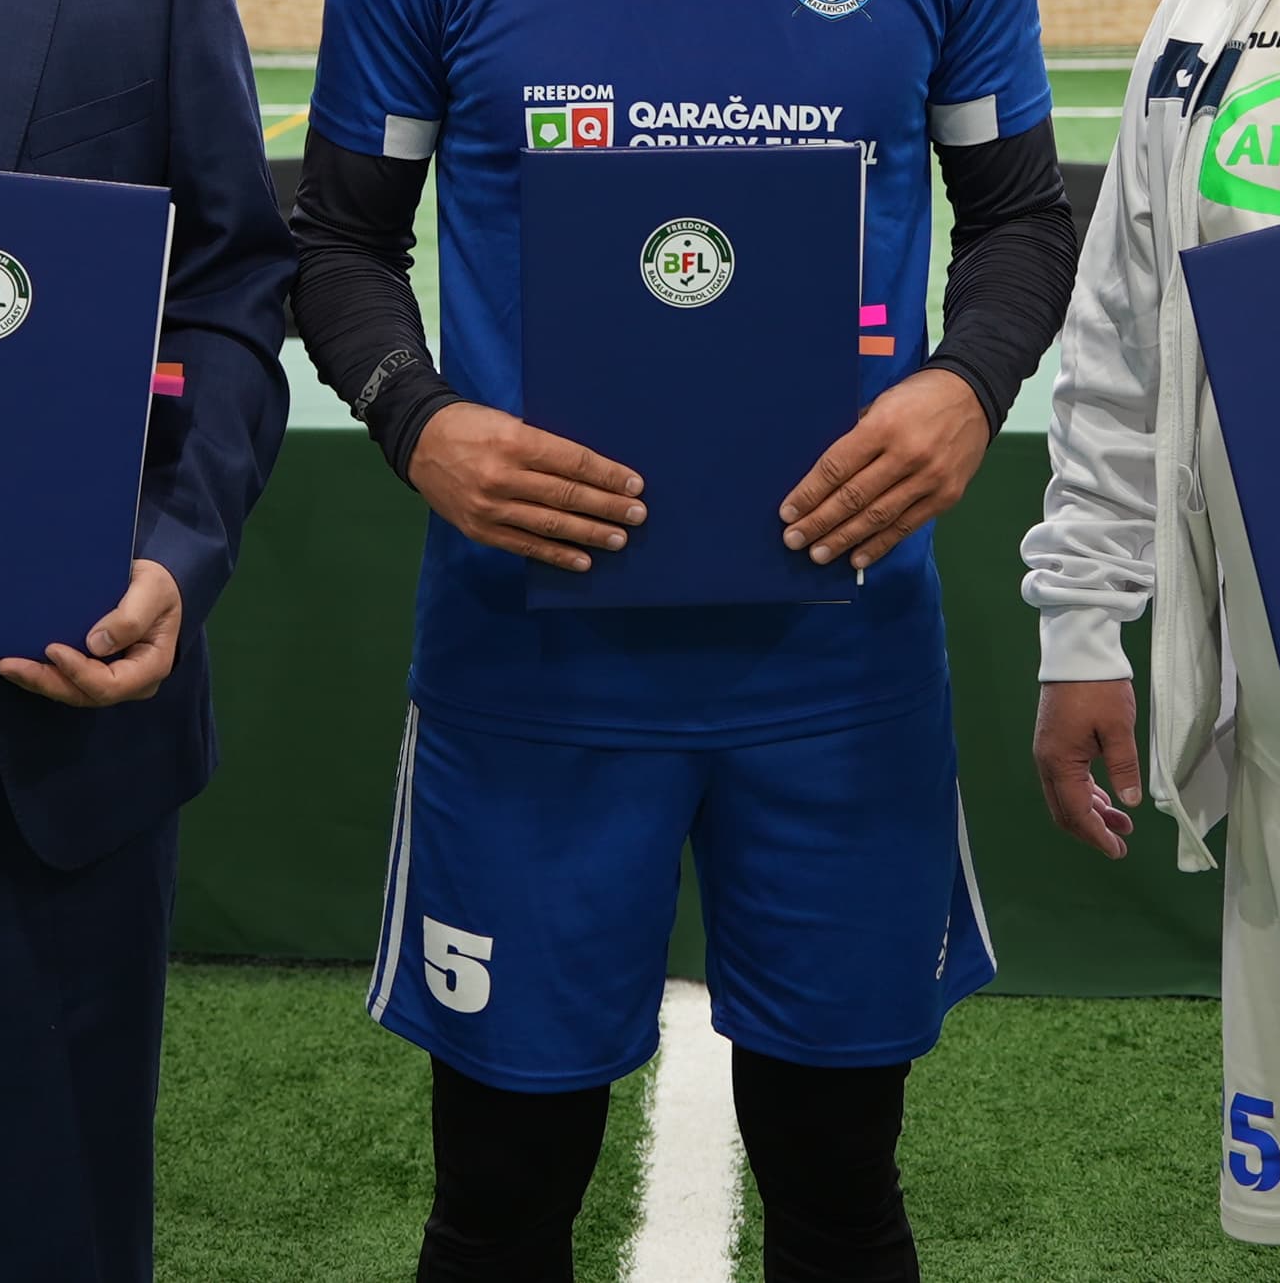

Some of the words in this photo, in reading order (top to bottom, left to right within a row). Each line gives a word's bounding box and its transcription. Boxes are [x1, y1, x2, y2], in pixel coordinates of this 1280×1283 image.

[523, 84, 615, 102] FREEDOM
[628, 94, 844, 133] QARAĞANDY
[666, 222, 709, 233] FREEDOM
[663, 252, 711, 274] BFL
[647, 269, 674, 300] BALALAR
[674, 293, 708, 303] FUTBOL
[705, 268, 728, 295] LIGASY
[0, 305, 23, 330] LIGASY
[422, 915, 494, 1014] 5
